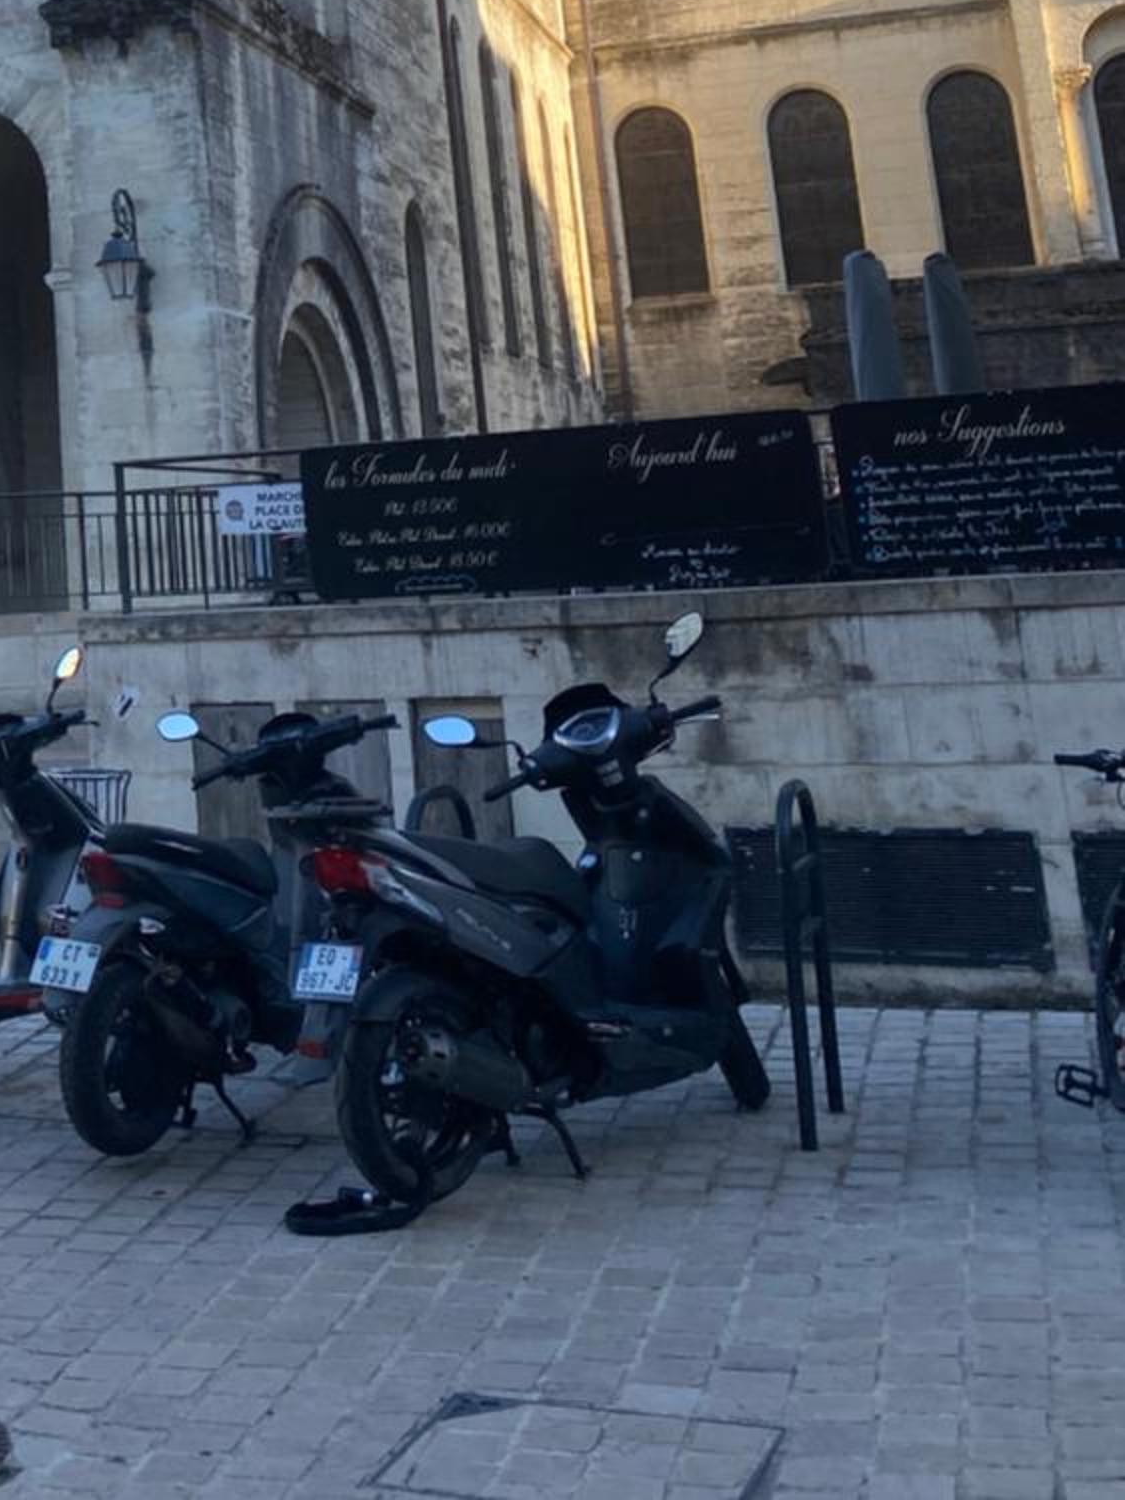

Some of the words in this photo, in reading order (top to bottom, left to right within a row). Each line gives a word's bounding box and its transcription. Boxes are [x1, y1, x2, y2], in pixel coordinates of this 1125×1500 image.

[893, 429, 929, 447] nos
[938, 403, 1066, 458] Suggestions
[606, 429, 738, 484] Aujourd'hui
[351, 452, 436, 488] Formules
[440, 451, 463, 482] du
[468, 448, 509, 480] midi
[256, 491, 301, 502] MARCH
[254, 503, 290, 516] PLACE
[249, 519, 264, 531] LA
[62, 943, 83, 963] CT
